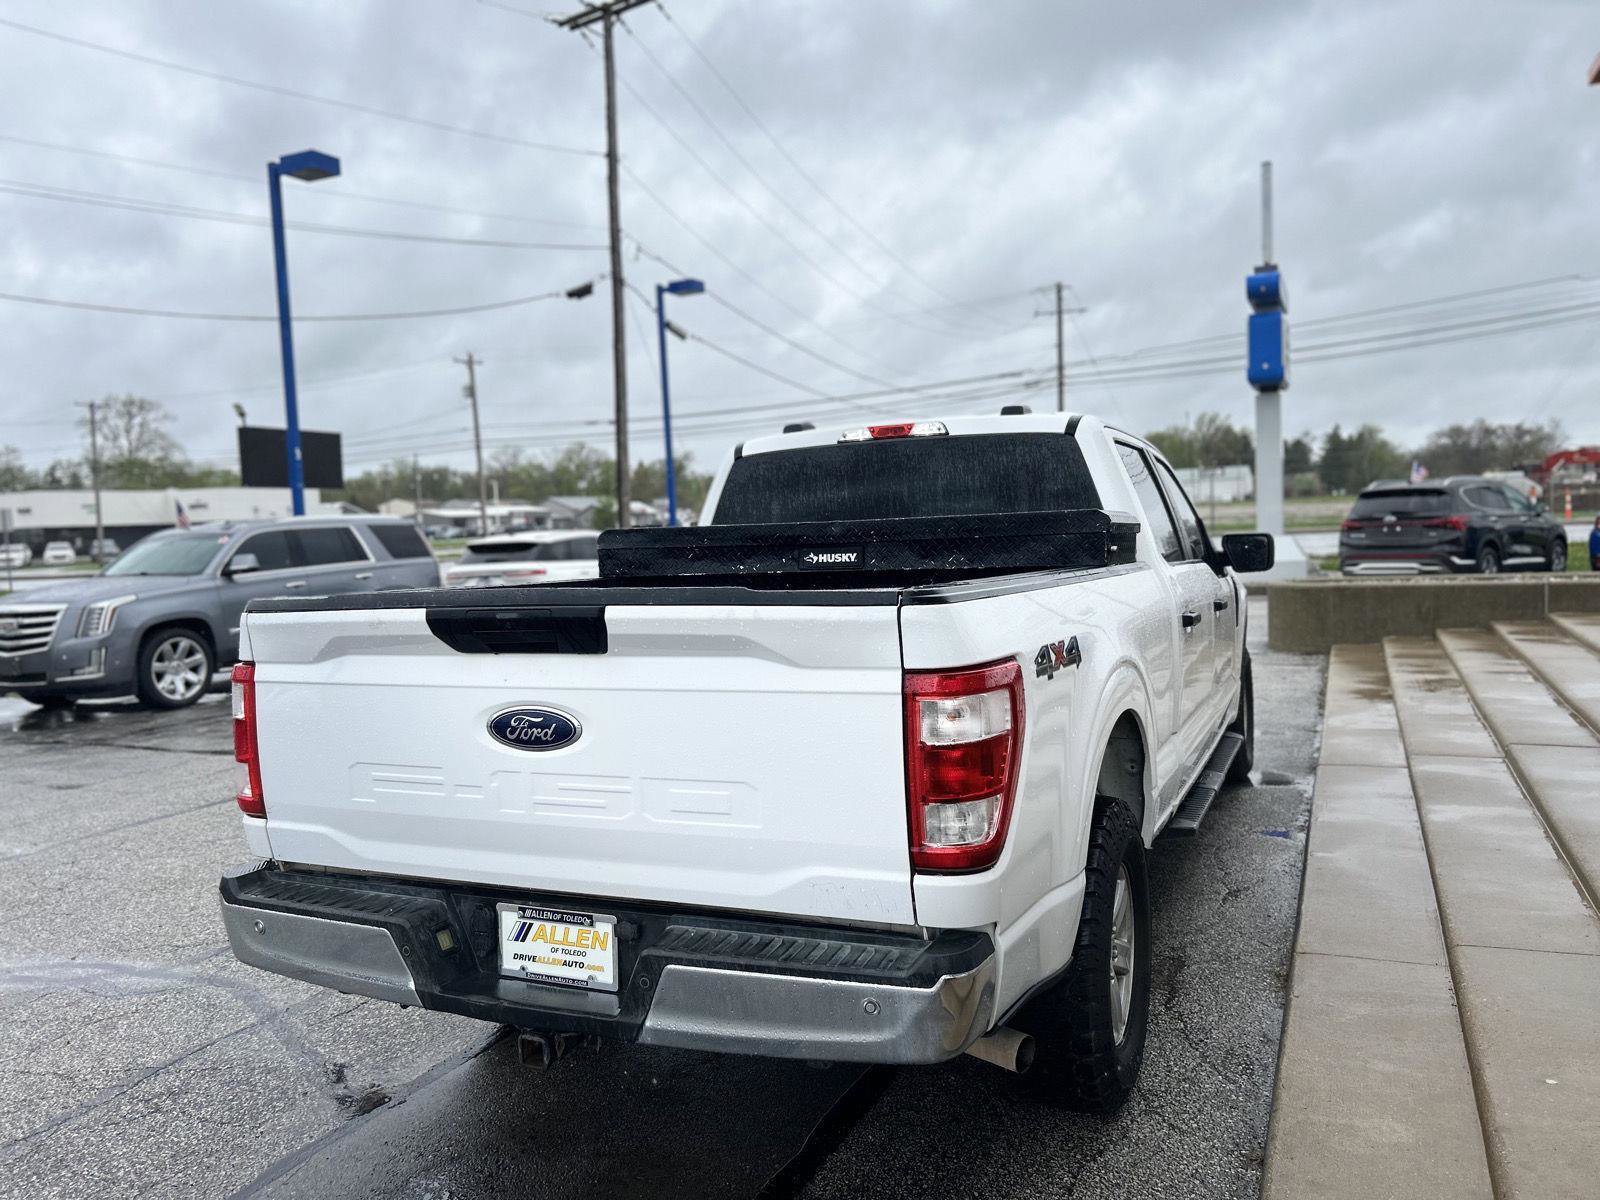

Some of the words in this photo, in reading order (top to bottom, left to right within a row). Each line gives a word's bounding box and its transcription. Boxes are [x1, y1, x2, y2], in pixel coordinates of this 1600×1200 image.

[818, 552, 857, 563] HUSKY
[506, 715, 556, 741] Ford
[531, 910, 553, 920] ALLEN
[562, 914, 588, 926] TOLEDO
[531, 924, 609, 951] ALLEN
[560, 948, 587, 957] TOLEDO
